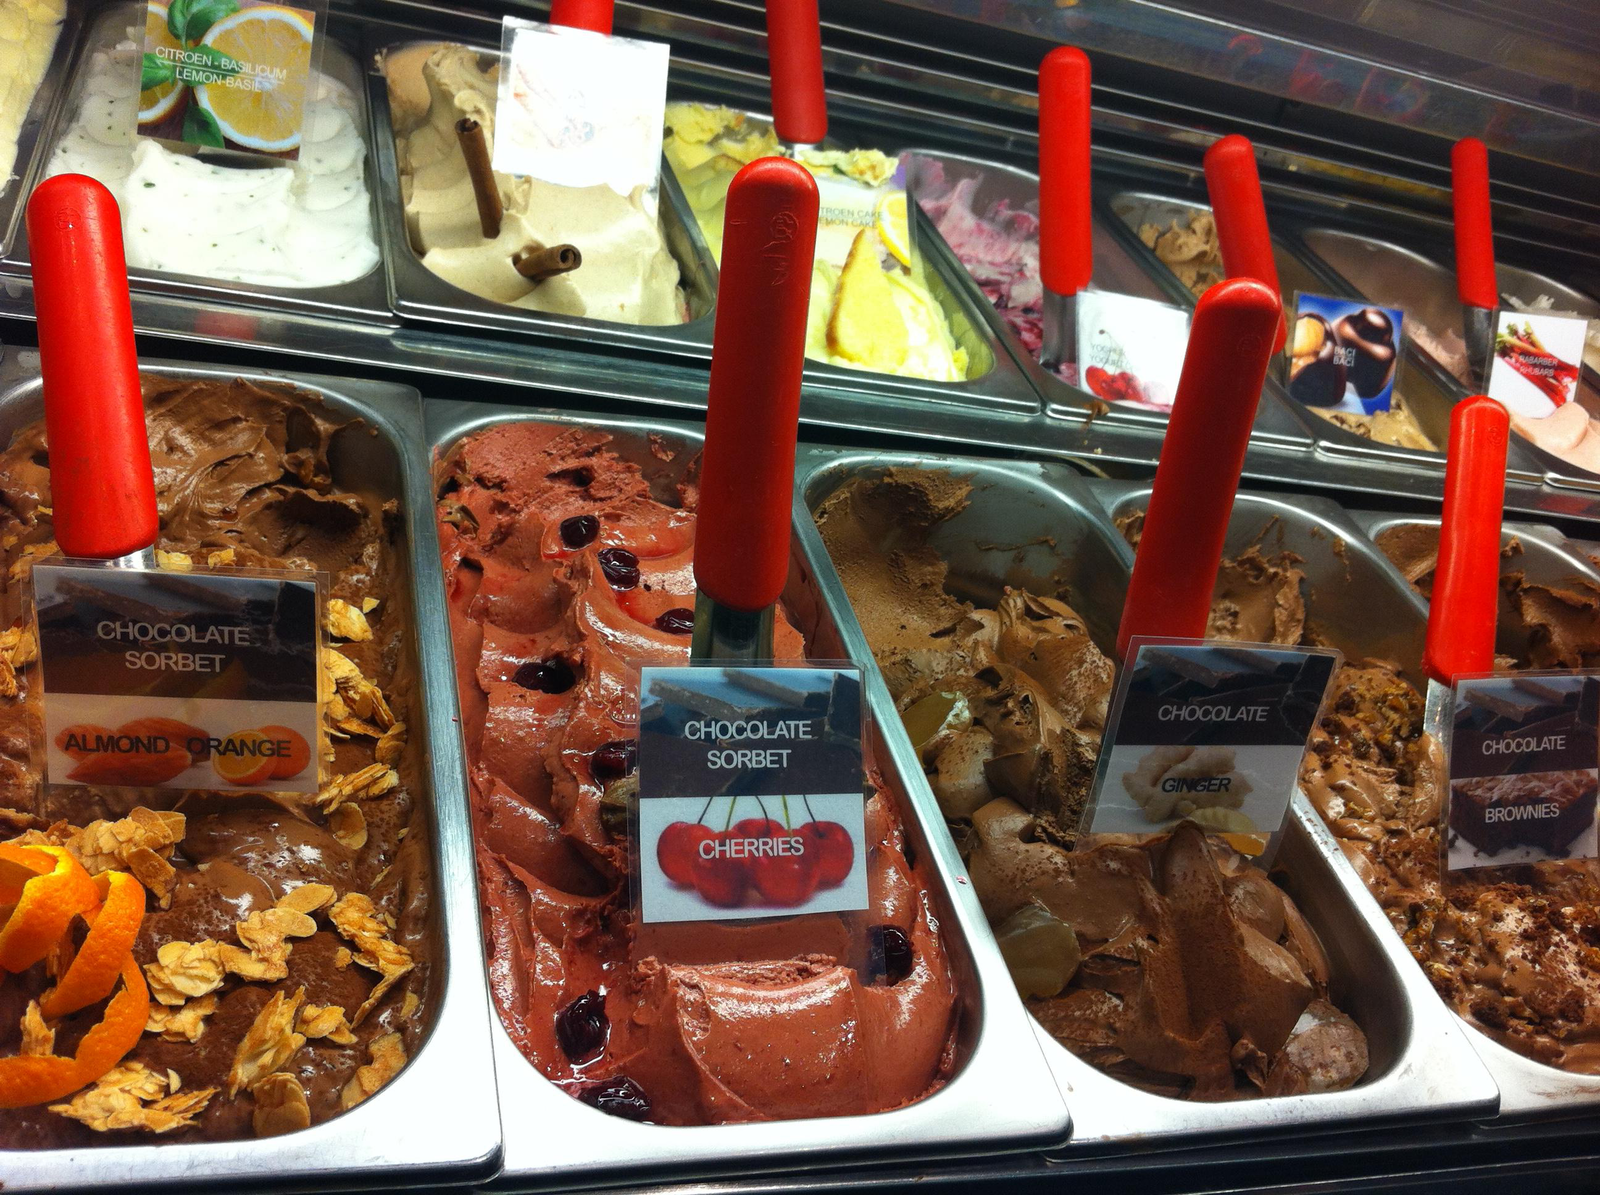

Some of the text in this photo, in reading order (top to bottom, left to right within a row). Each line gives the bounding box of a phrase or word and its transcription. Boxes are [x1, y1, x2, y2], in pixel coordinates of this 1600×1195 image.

[155, 46, 212, 67] CITROEN
[221, 58, 287, 80] BASILICUM
[176, 68, 262, 92] LEMON-BASIL
[819, 217, 849, 227] EMON
[820, 207, 854, 217] TROEN
[1334, 345, 1356, 357] BACI
[1333, 356, 1354, 367] BACI
[97, 620, 250, 646] CHOCOLATE
[125, 651, 226, 672] SORBET
[1158, 704, 1270, 722] CHOCOLATE
[684, 720, 812, 740] CHOCOLATE
[65, 733, 292, 758] ALMOND ORANGE
[1482, 735, 1566, 756] CHOCOLATE
[707, 749, 792, 769] SORBET
[1161, 777, 1232, 794] GINGER
[1485, 803, 1560, 823] BROWNIES
[699, 837, 804, 860] CHERRIES
